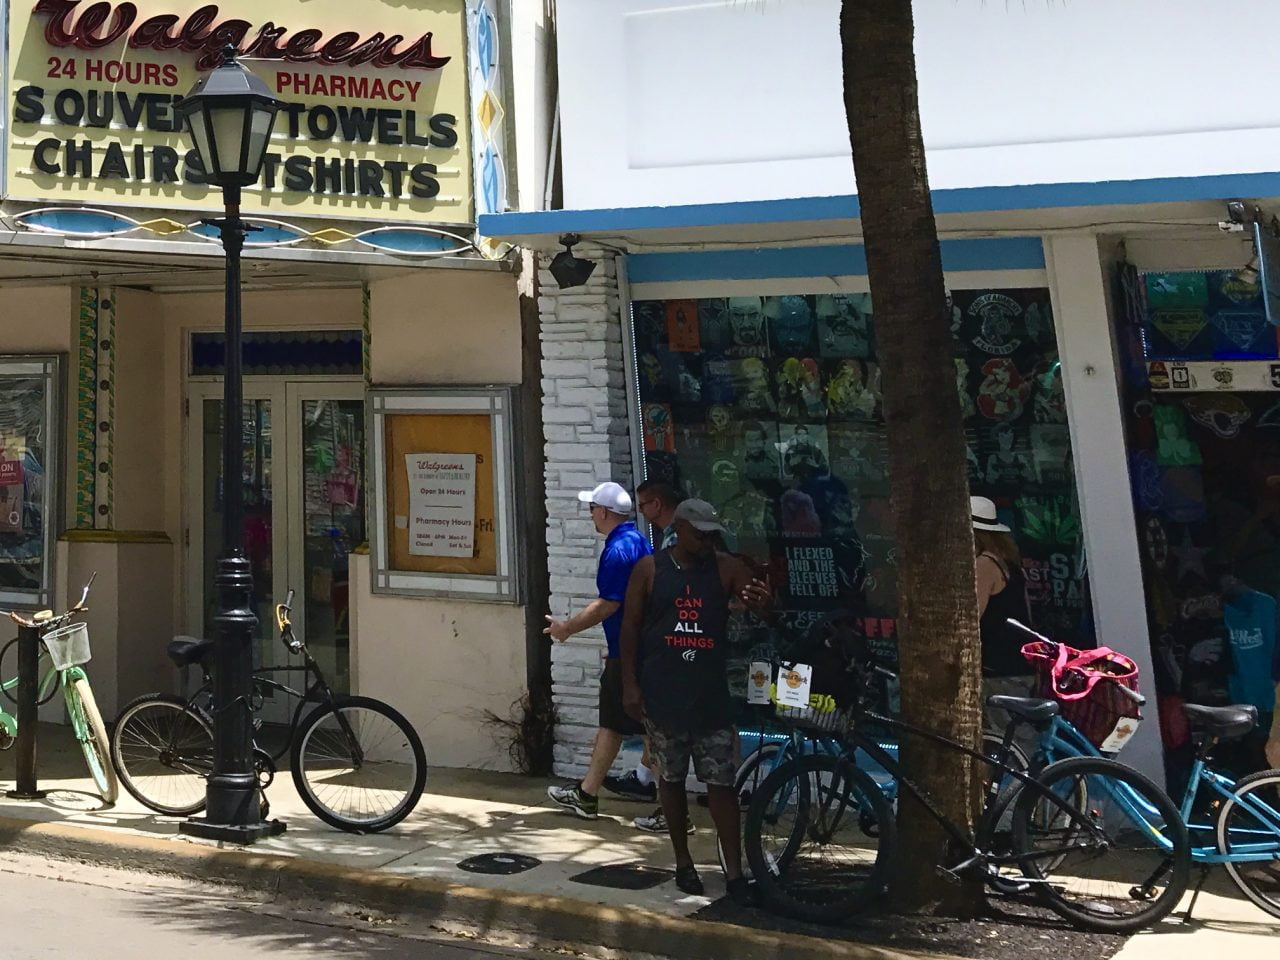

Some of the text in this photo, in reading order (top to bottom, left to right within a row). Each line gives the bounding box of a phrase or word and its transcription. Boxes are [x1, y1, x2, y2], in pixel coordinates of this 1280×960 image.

[47, 57, 421, 102] 24 HOURS PHARMACY
[285, 103, 458, 147] TOWELS
[34, 138, 440, 198] CHAIRS TSHIRTS
[0, 463, 14, 472] ON
[416, 460, 465, 473] Walgreens
[446, 488, 466, 496] Hours
[415, 517, 450, 527] Pharmacy
[785, 546, 834, 560] I FLEXED
[788, 559, 836, 572] AND THE
[789, 571, 838, 585] SLEEVES
[790, 583, 840, 597] FELL OFF
[674, 597, 703, 608] CAN
[679, 609, 700, 620] DO
[674, 621, 704, 633] ALL
[663, 635, 715, 649] THINGS
